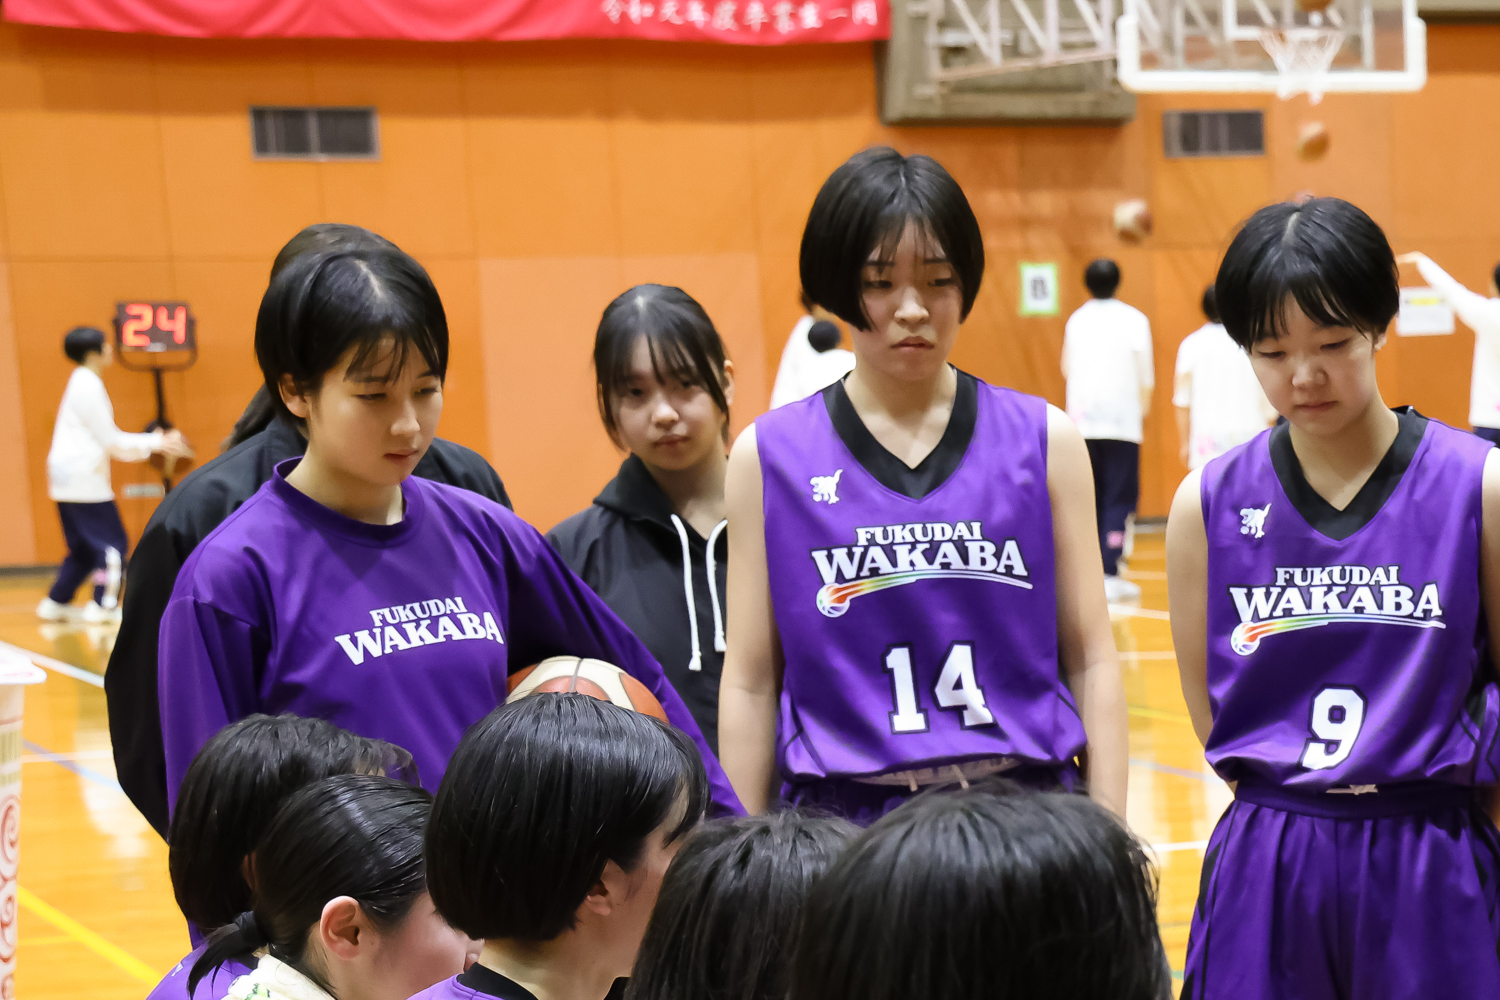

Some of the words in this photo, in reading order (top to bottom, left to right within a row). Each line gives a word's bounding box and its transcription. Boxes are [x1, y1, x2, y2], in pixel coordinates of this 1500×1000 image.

[122, 303, 187, 347] 24
[855, 521, 983, 547] FUKUDAI
[811, 539, 1029, 585] WAKABA
[1275, 565, 1400, 586] FUKUDAI
[369, 596, 468, 627] FUKUDAI
[1229, 583, 1443, 623] WAKABA
[334, 611, 504, 666] WAKABA
[882, 641, 998, 734] 14
[1299, 685, 1368, 772] 9
